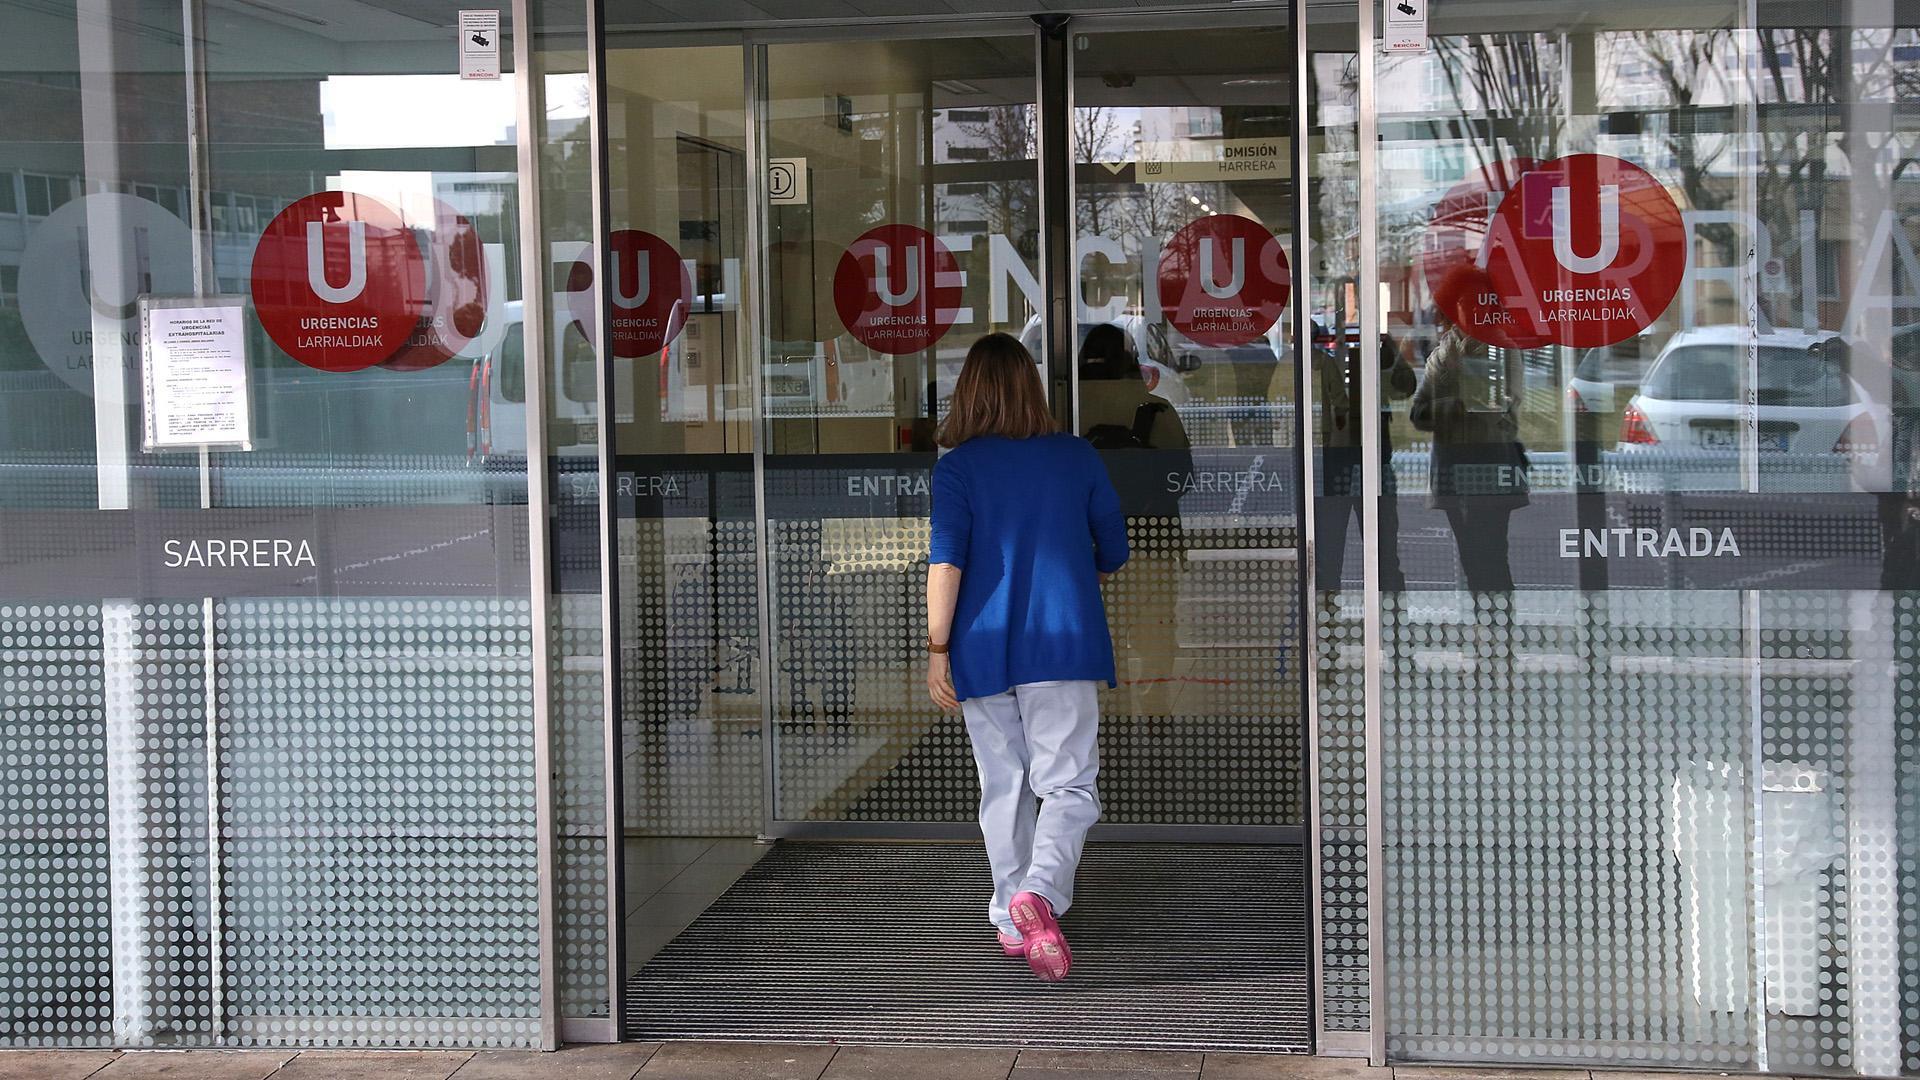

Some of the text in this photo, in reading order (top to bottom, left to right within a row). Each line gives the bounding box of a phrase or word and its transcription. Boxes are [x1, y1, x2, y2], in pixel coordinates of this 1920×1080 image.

[1220, 143, 1277, 158] DMISIÓN
[1218, 160, 1277, 172] HARRERA
[1551, 184, 1620, 274] U
[306, 221, 367, 304] U
[1199, 237, 1246, 299] U
[611, 249, 651, 309] U
[874, 245, 919, 307] U
[1543, 287, 1631, 302] URGENCIAS
[870, 315, 927, 326] URGENCIAS
[1193, 308, 1253, 319] URGENCIAS
[1539, 307, 1636, 323] LARRIALDIAK
[301, 316, 379, 330] URGENCIAS
[611, 318, 658, 328] RGENCIAS
[1190, 321, 1256, 332] LARRIALDIAK
[298, 335, 383, 348] LARRIALDIAK
[867, 328, 930, 340] LARRIALDIAK
[571, 476, 681, 497] SARERA
[847, 475, 930, 497] ENTRA
[1167, 471, 1283, 493] SARRERA
[1559, 527, 1741, 558] ENTRADA
[164, 539, 316, 568] SARRERA
